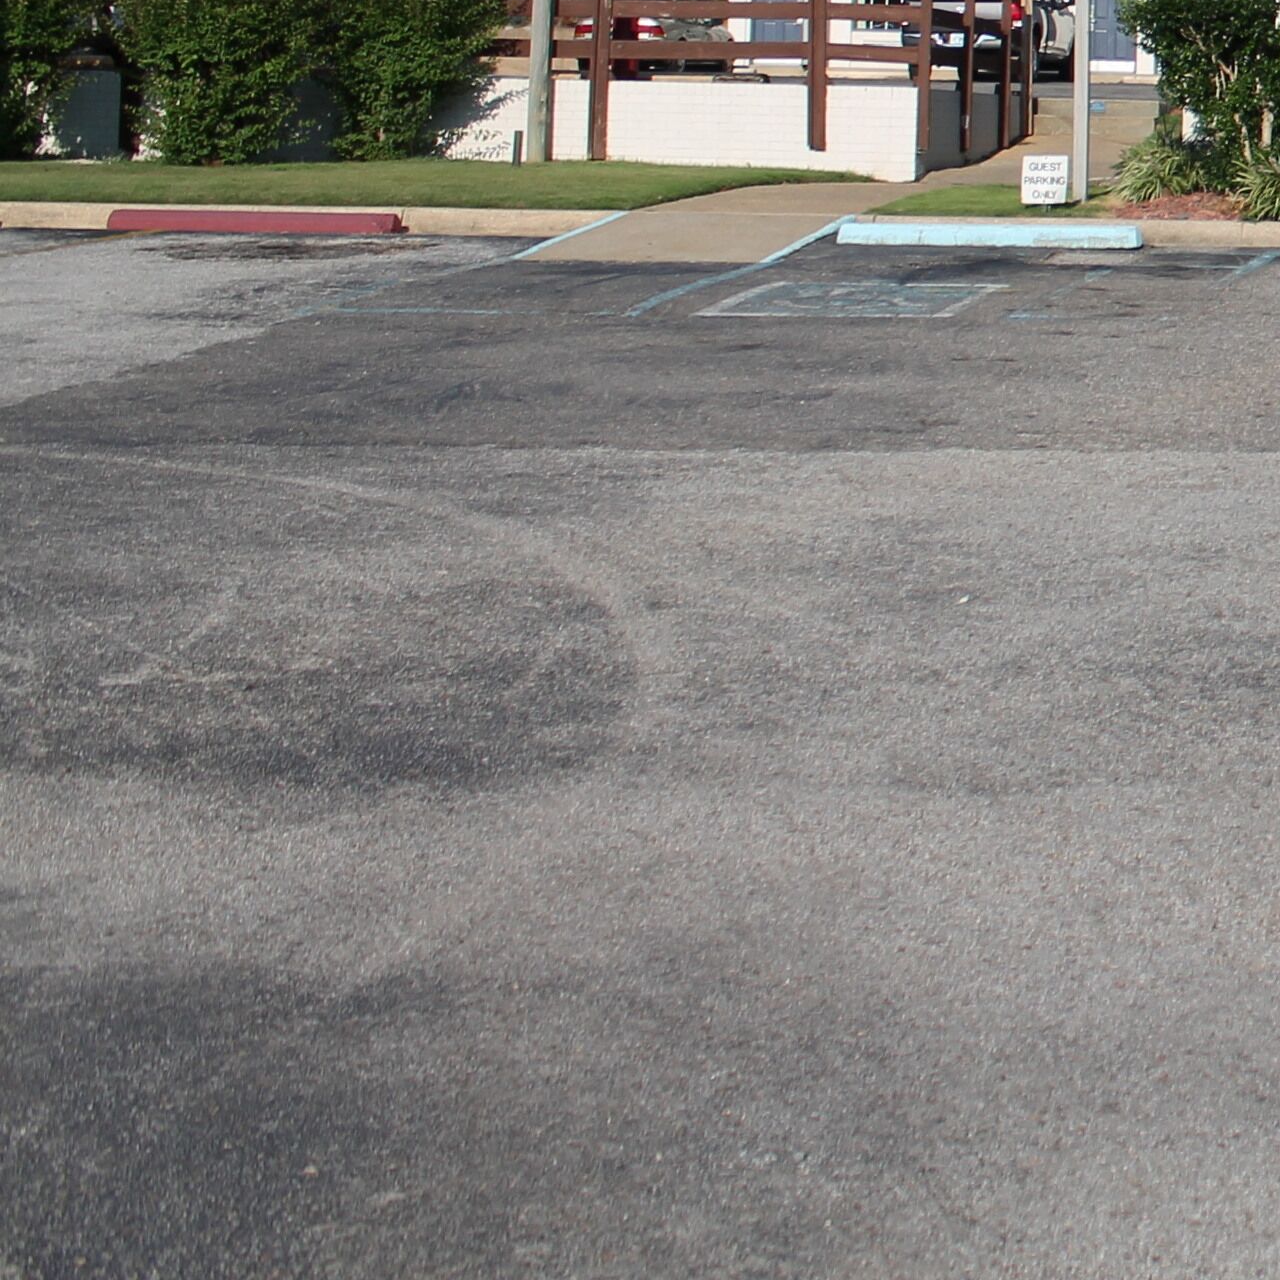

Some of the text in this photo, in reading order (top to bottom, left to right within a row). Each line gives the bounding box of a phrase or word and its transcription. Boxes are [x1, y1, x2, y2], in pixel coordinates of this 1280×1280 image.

[1029, 162, 1062, 171] GUEST
[1024, 176, 1066, 186] PARKING
[1032, 189, 1057, 199] ONLY
